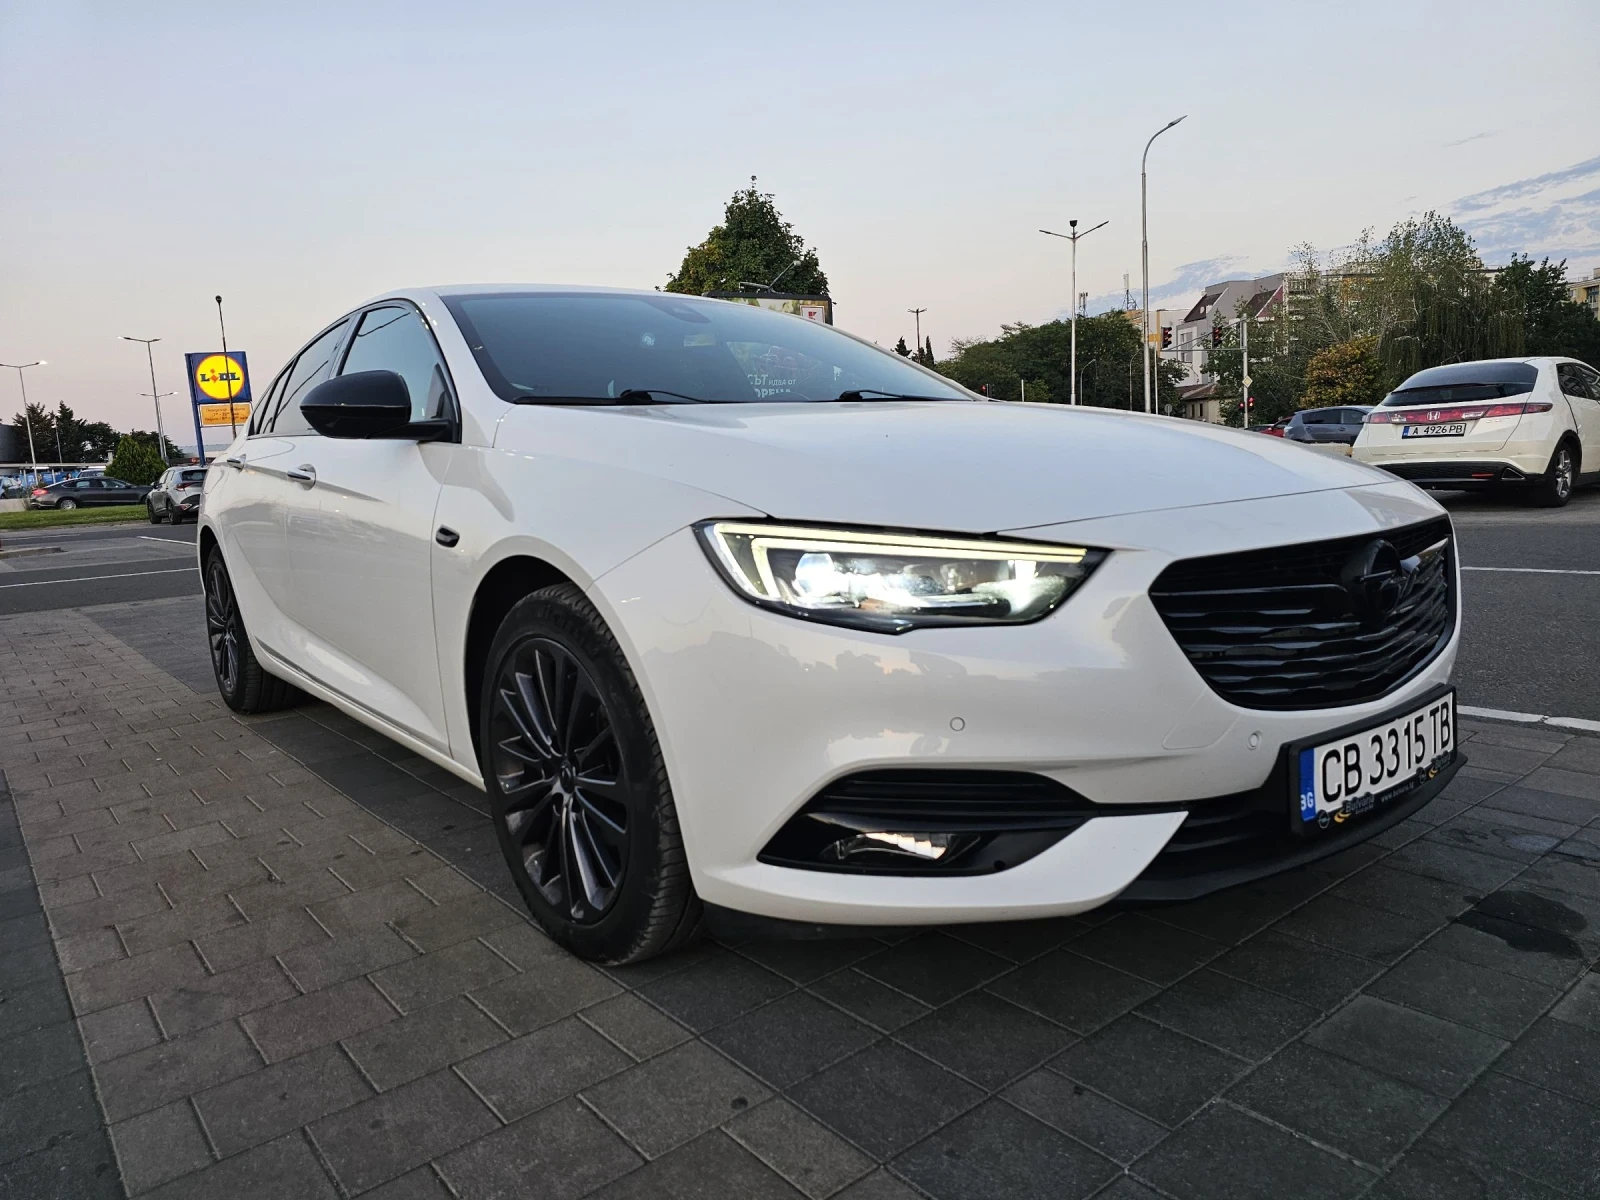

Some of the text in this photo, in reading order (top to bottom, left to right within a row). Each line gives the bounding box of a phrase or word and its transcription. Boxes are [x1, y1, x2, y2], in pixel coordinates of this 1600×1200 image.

[1412, 427, 1419, 435] A
[1423, 426, 1448, 435] 4926
[1448, 425, 1463, 434] PB
[1322, 701, 1451, 803] CB 3315 TB
